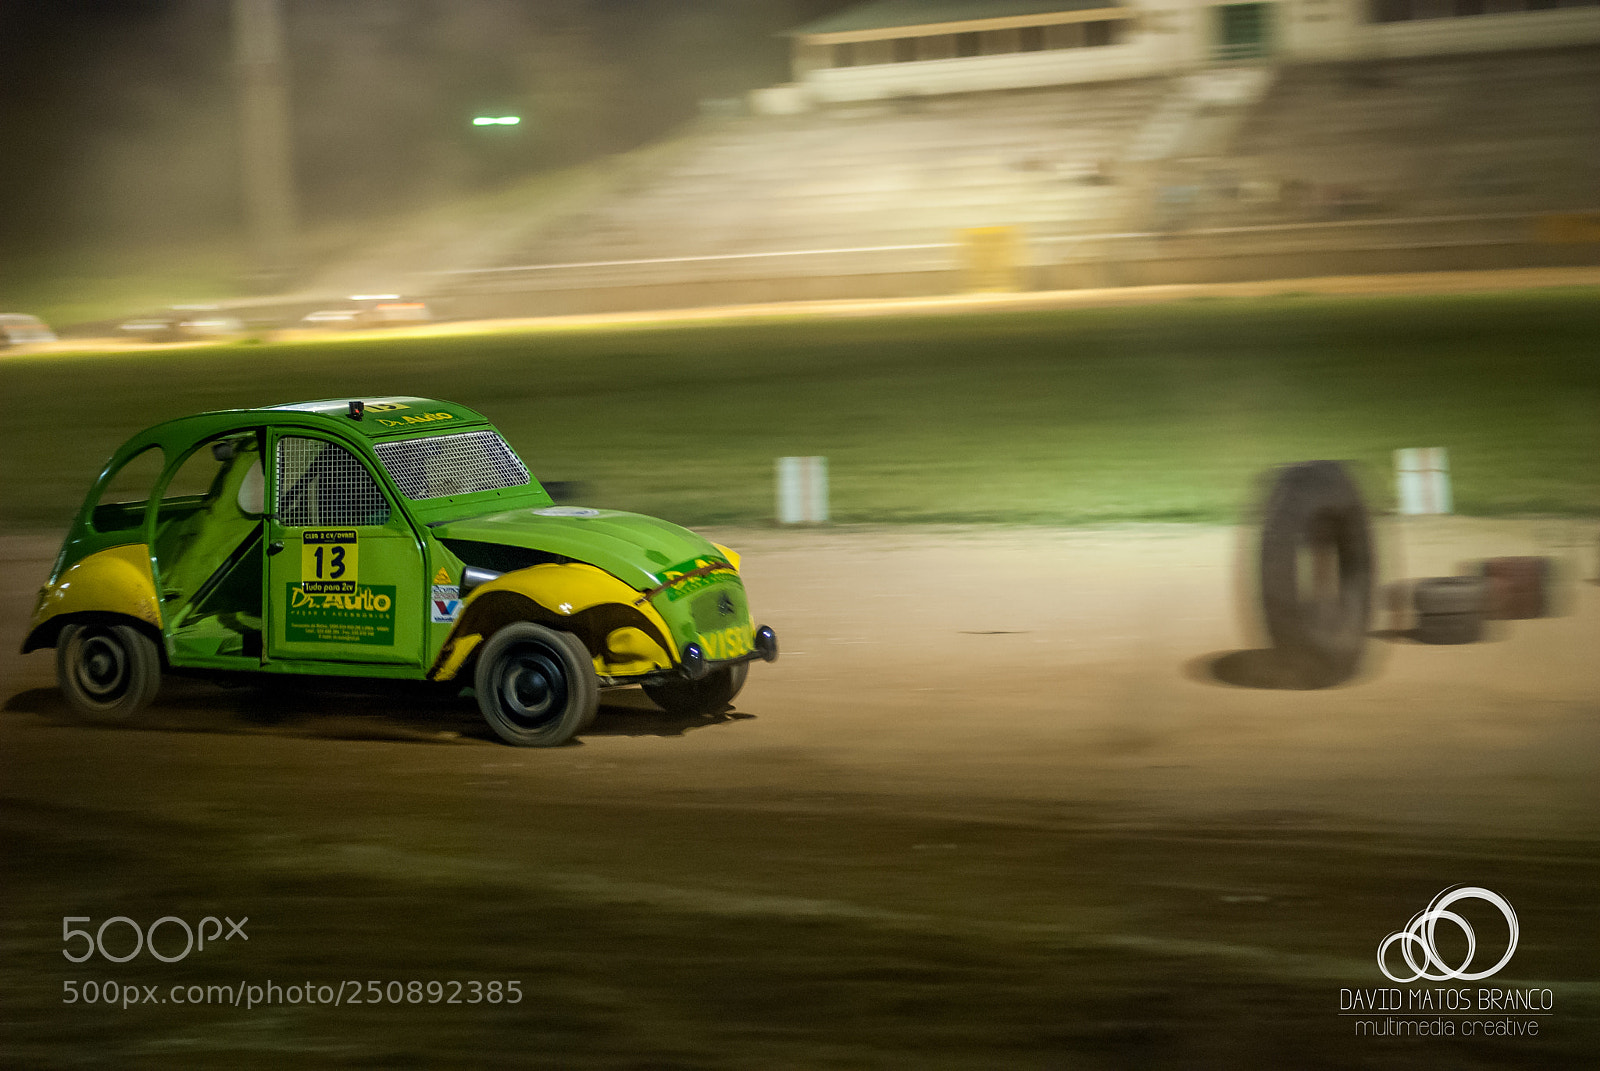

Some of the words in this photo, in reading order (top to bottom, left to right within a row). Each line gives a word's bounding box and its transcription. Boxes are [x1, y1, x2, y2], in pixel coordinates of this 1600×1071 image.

[401, 412, 453, 424] Auto
[314, 546, 346, 580] 13
[304, 582, 322, 592] Tudo
[323, 583, 340, 593] para
[341, 582, 354, 592] 2cv
[291, 587, 321, 609] Dr.
[322, 587, 392, 612] Auto
